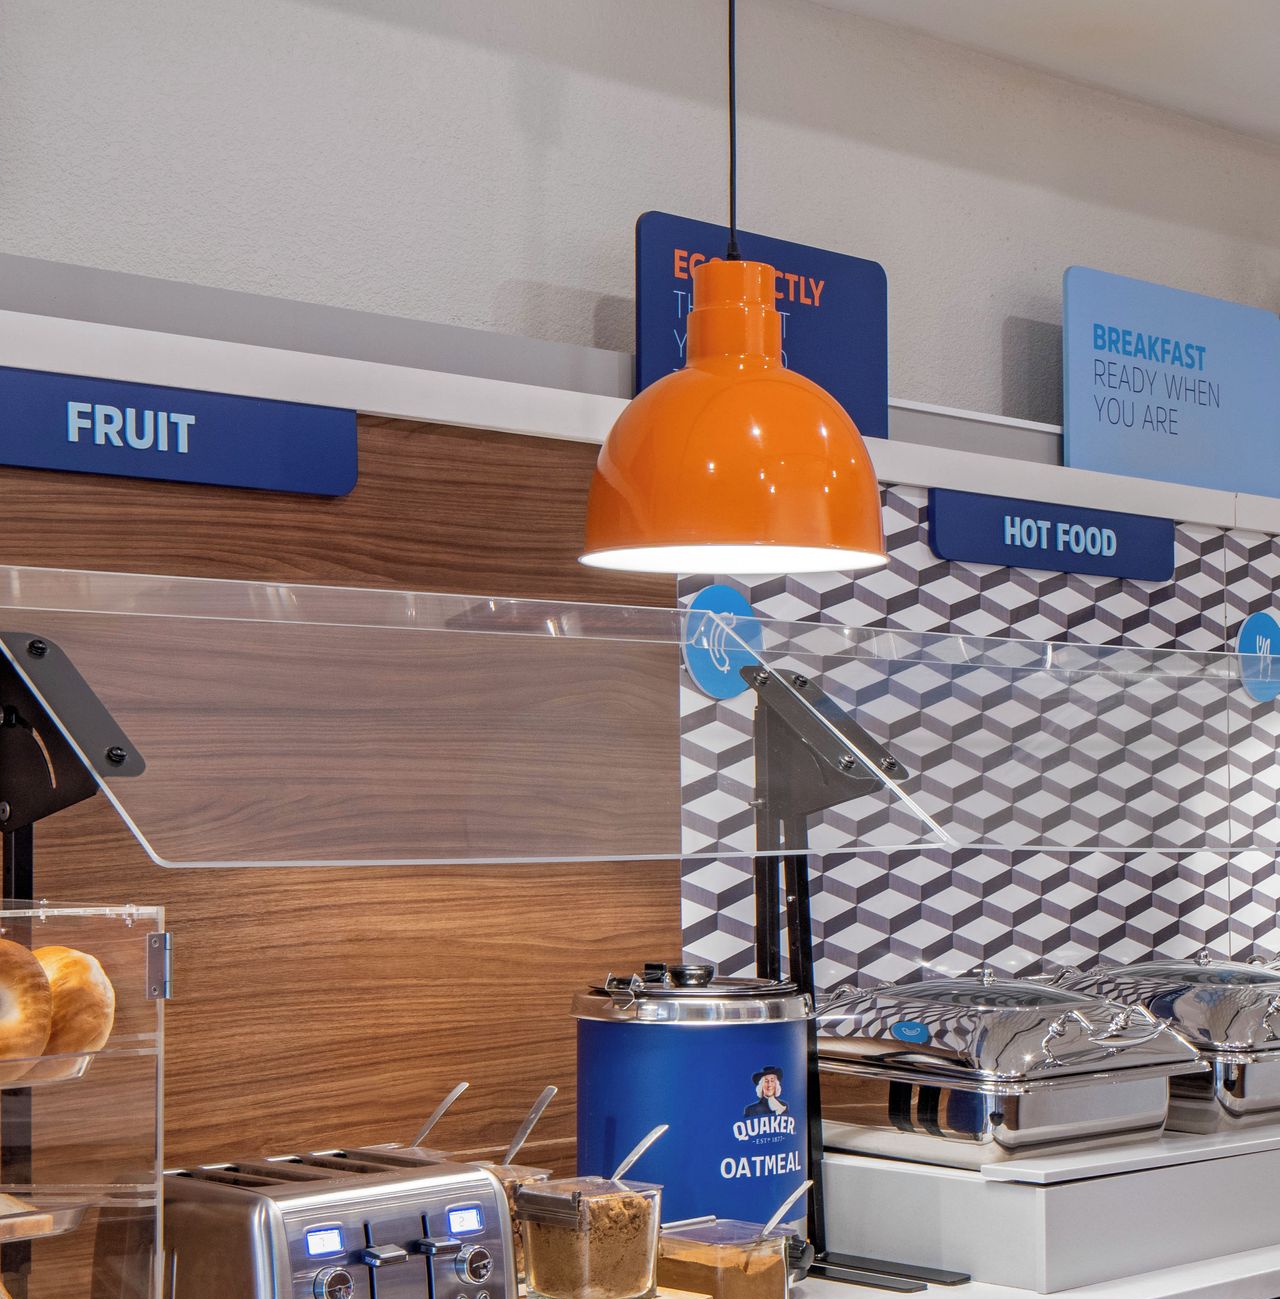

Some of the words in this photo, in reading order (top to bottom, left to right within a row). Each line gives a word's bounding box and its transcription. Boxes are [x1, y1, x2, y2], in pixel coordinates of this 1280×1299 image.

[673, 248, 825, 307] ECTLY
[1093, 322, 1207, 371] BREAKFAST
[1093, 358, 1158, 396] READY
[1164, 372, 1220, 408] WHEN
[67, 401, 196, 454] FRUIT
[1093, 394, 1135, 428] YOU
[1141, 404, 1179, 436] ARE
[1004, 515, 1052, 550] HOT
[1056, 522, 1117, 557] FOOD
[732, 1115, 796, 1141] QUAKER
[720, 1150, 801, 1179] OATMEAL
